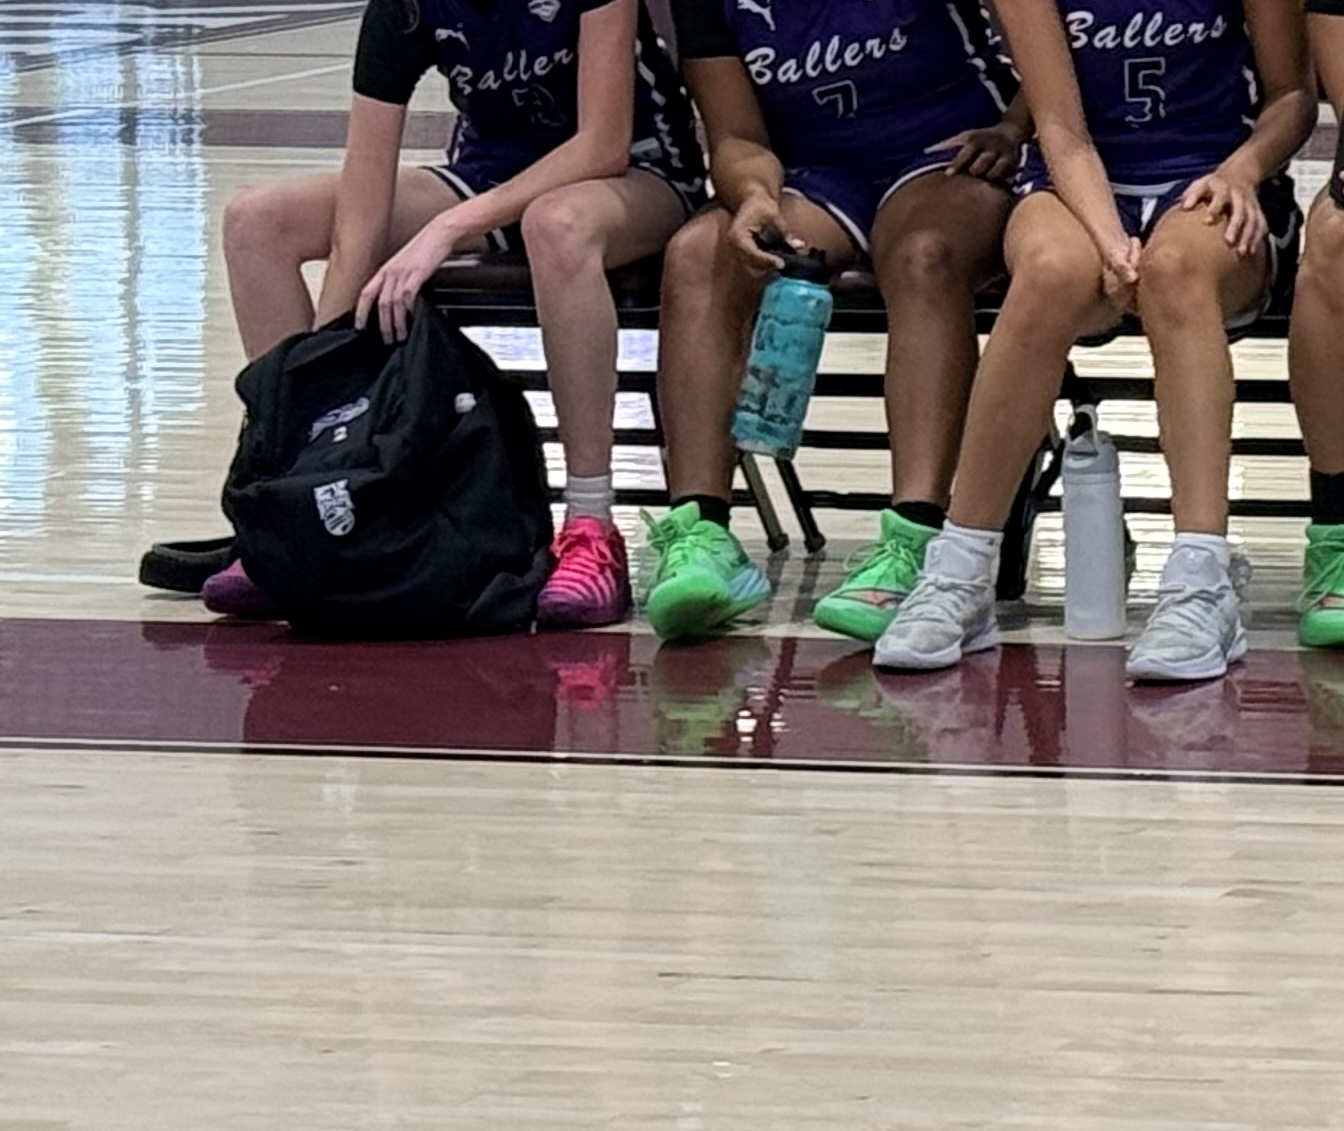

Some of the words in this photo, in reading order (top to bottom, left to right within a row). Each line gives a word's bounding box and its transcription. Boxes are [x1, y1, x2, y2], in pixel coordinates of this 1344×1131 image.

[1065, 10, 1228, 50] Ballers
[744, 27, 908, 86] Ballers
[811, 79, 858, 119] 7
[1123, 56, 1167, 129] 5
